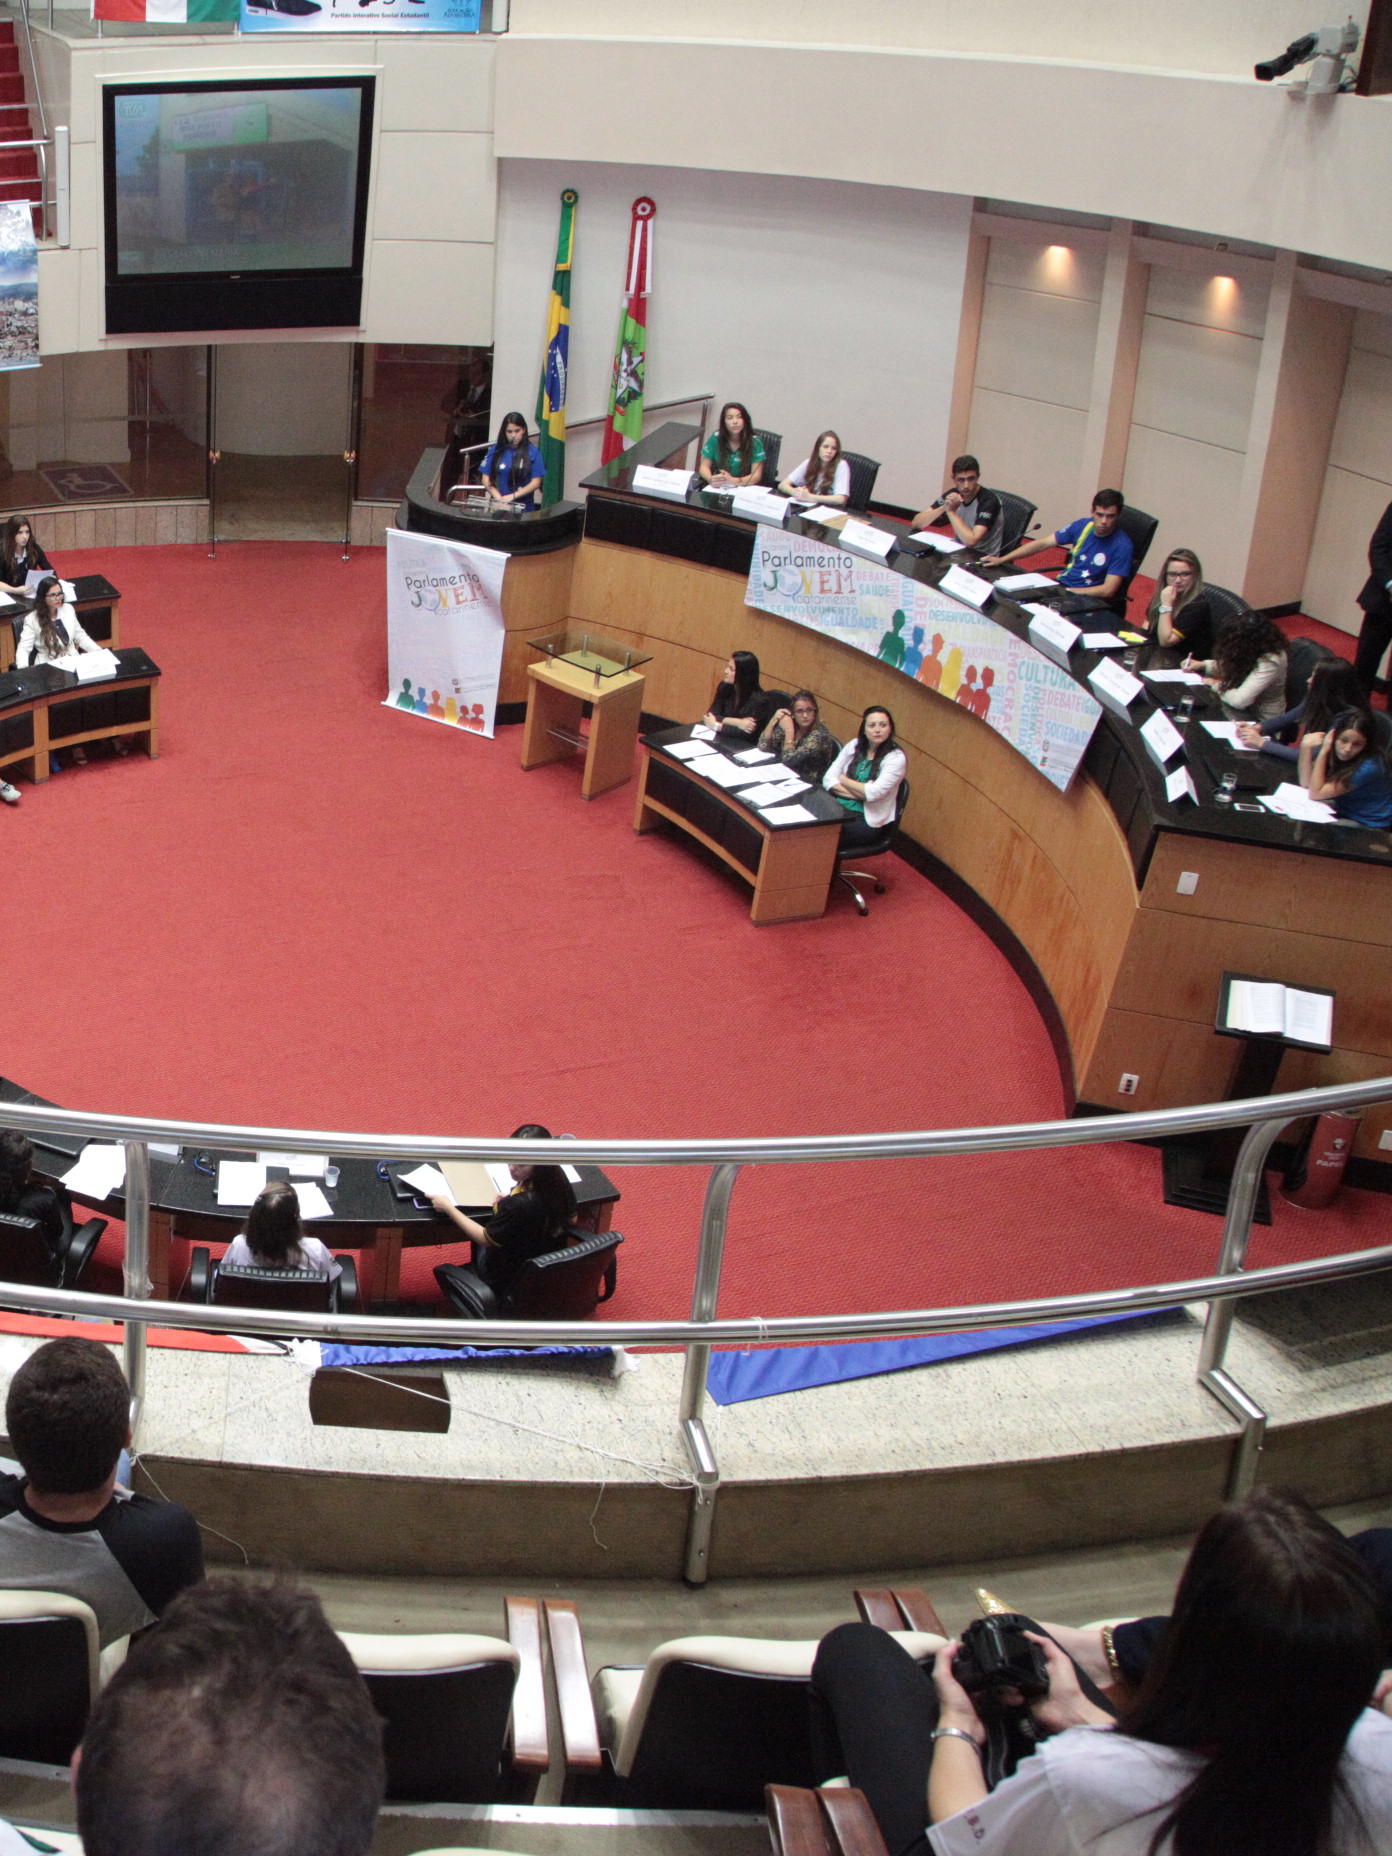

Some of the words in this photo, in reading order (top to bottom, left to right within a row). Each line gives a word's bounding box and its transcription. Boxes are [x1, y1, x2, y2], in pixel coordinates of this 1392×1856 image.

[761, 550, 854, 569] Parlamento
[405, 572, 480, 590] Parlamento
[763, 565, 857, 599] JOVEM
[856, 570, 891, 582] DEBATE
[795, 594, 857, 606] catarinense
[1047, 690, 1082, 713] DEBATE
